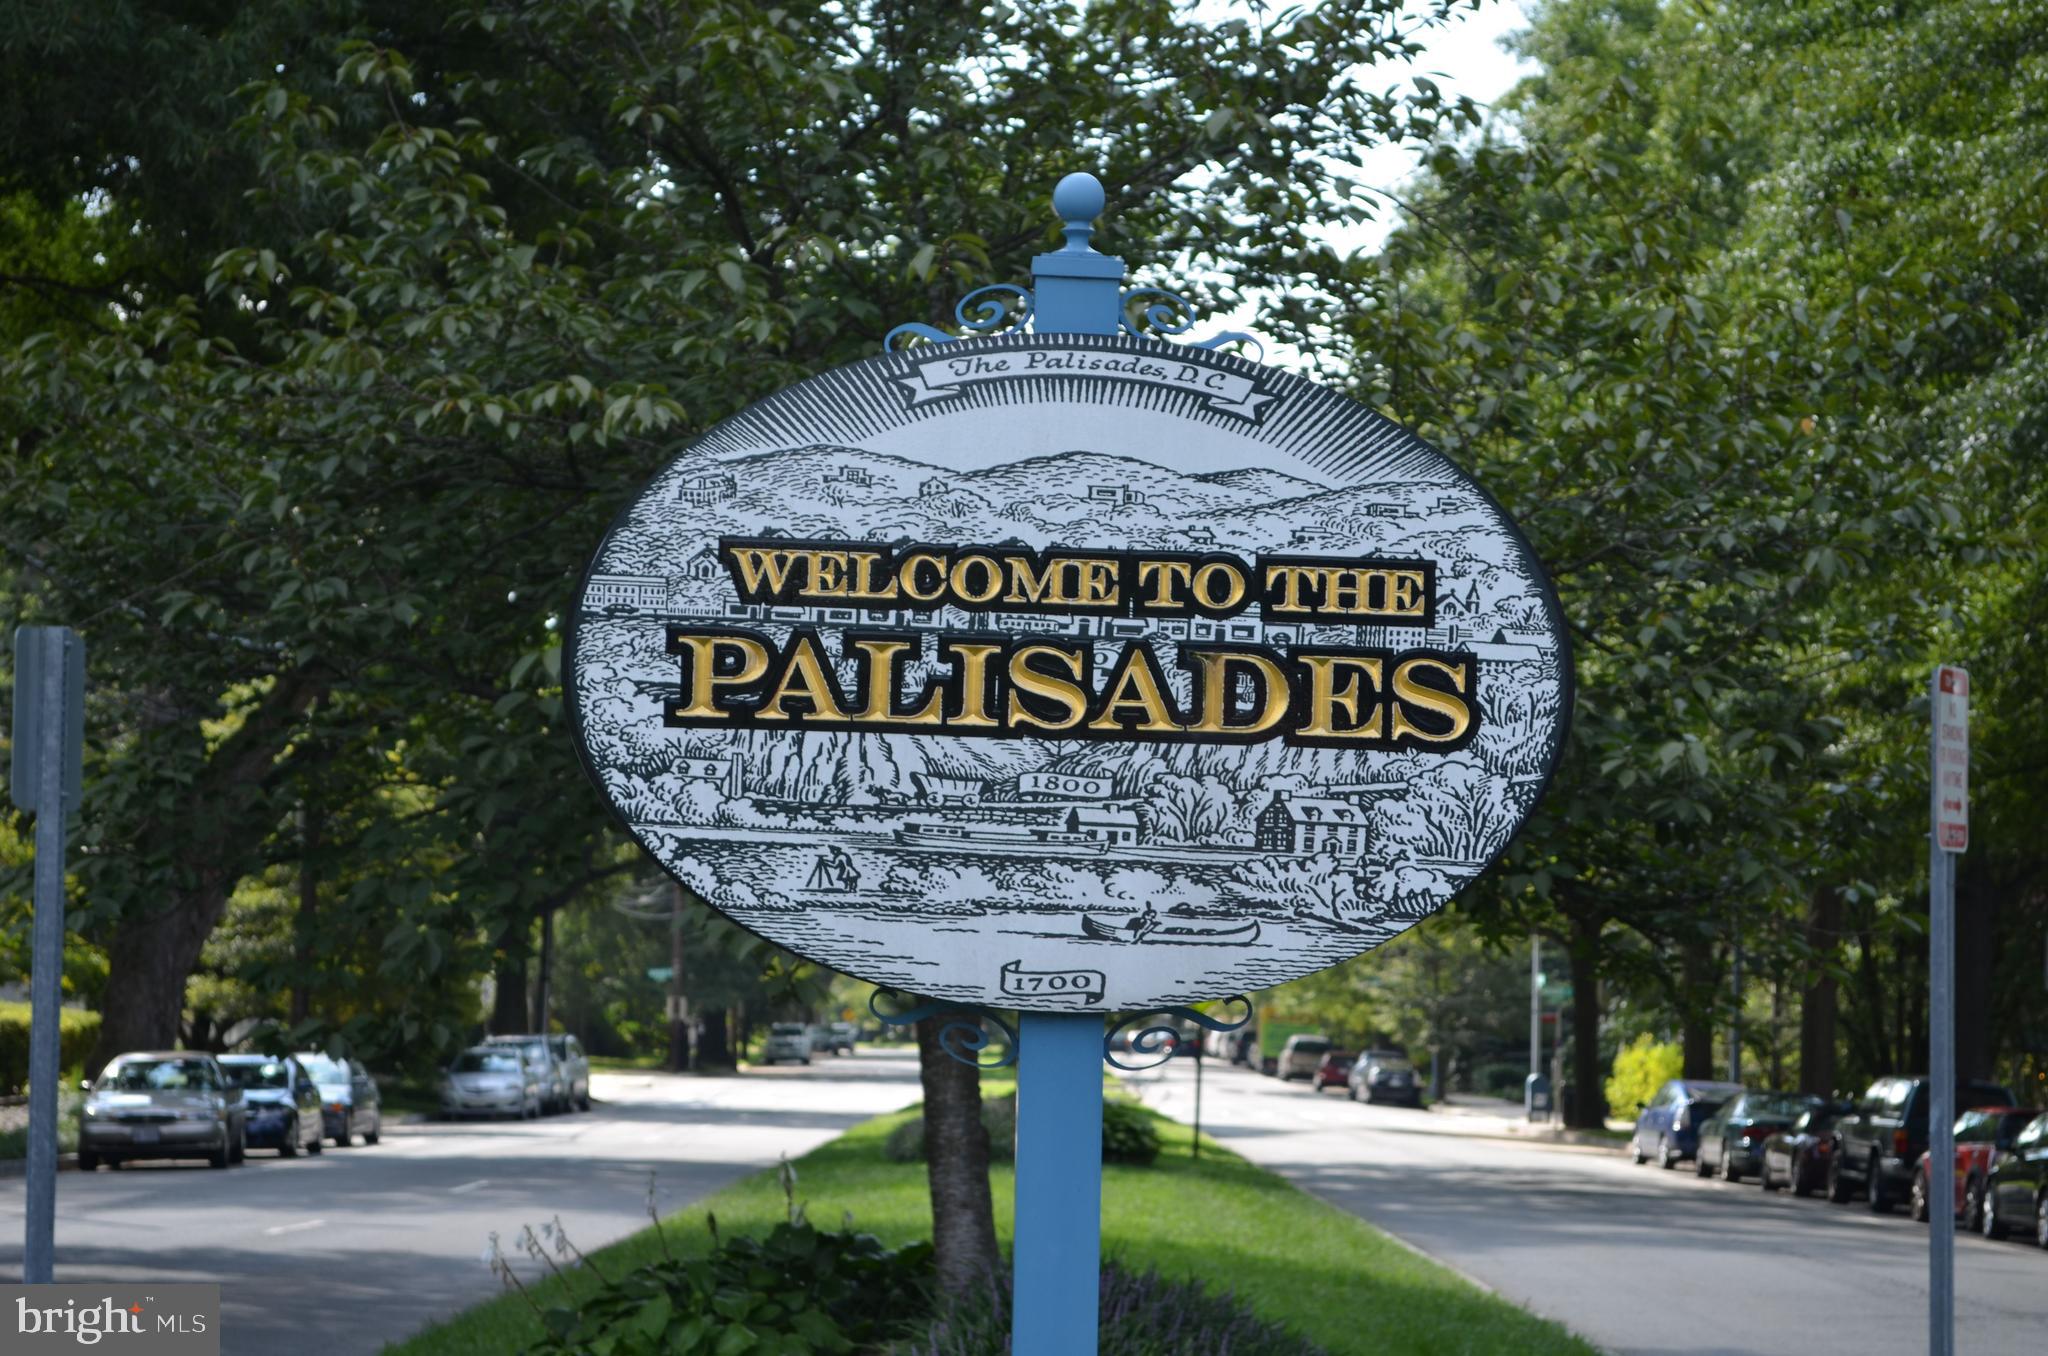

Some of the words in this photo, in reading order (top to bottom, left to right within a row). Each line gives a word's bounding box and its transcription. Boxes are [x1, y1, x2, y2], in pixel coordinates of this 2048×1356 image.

[948, 356, 1011, 377] The
[730, 548, 1120, 606] WELCOME
[1138, 561, 1246, 610] TO
[1266, 565, 1426, 617] THE
[675, 635, 1471, 742] PALISADES
[1031, 776, 1100, 794] 1800
[1013, 974, 1092, 992] 1700
